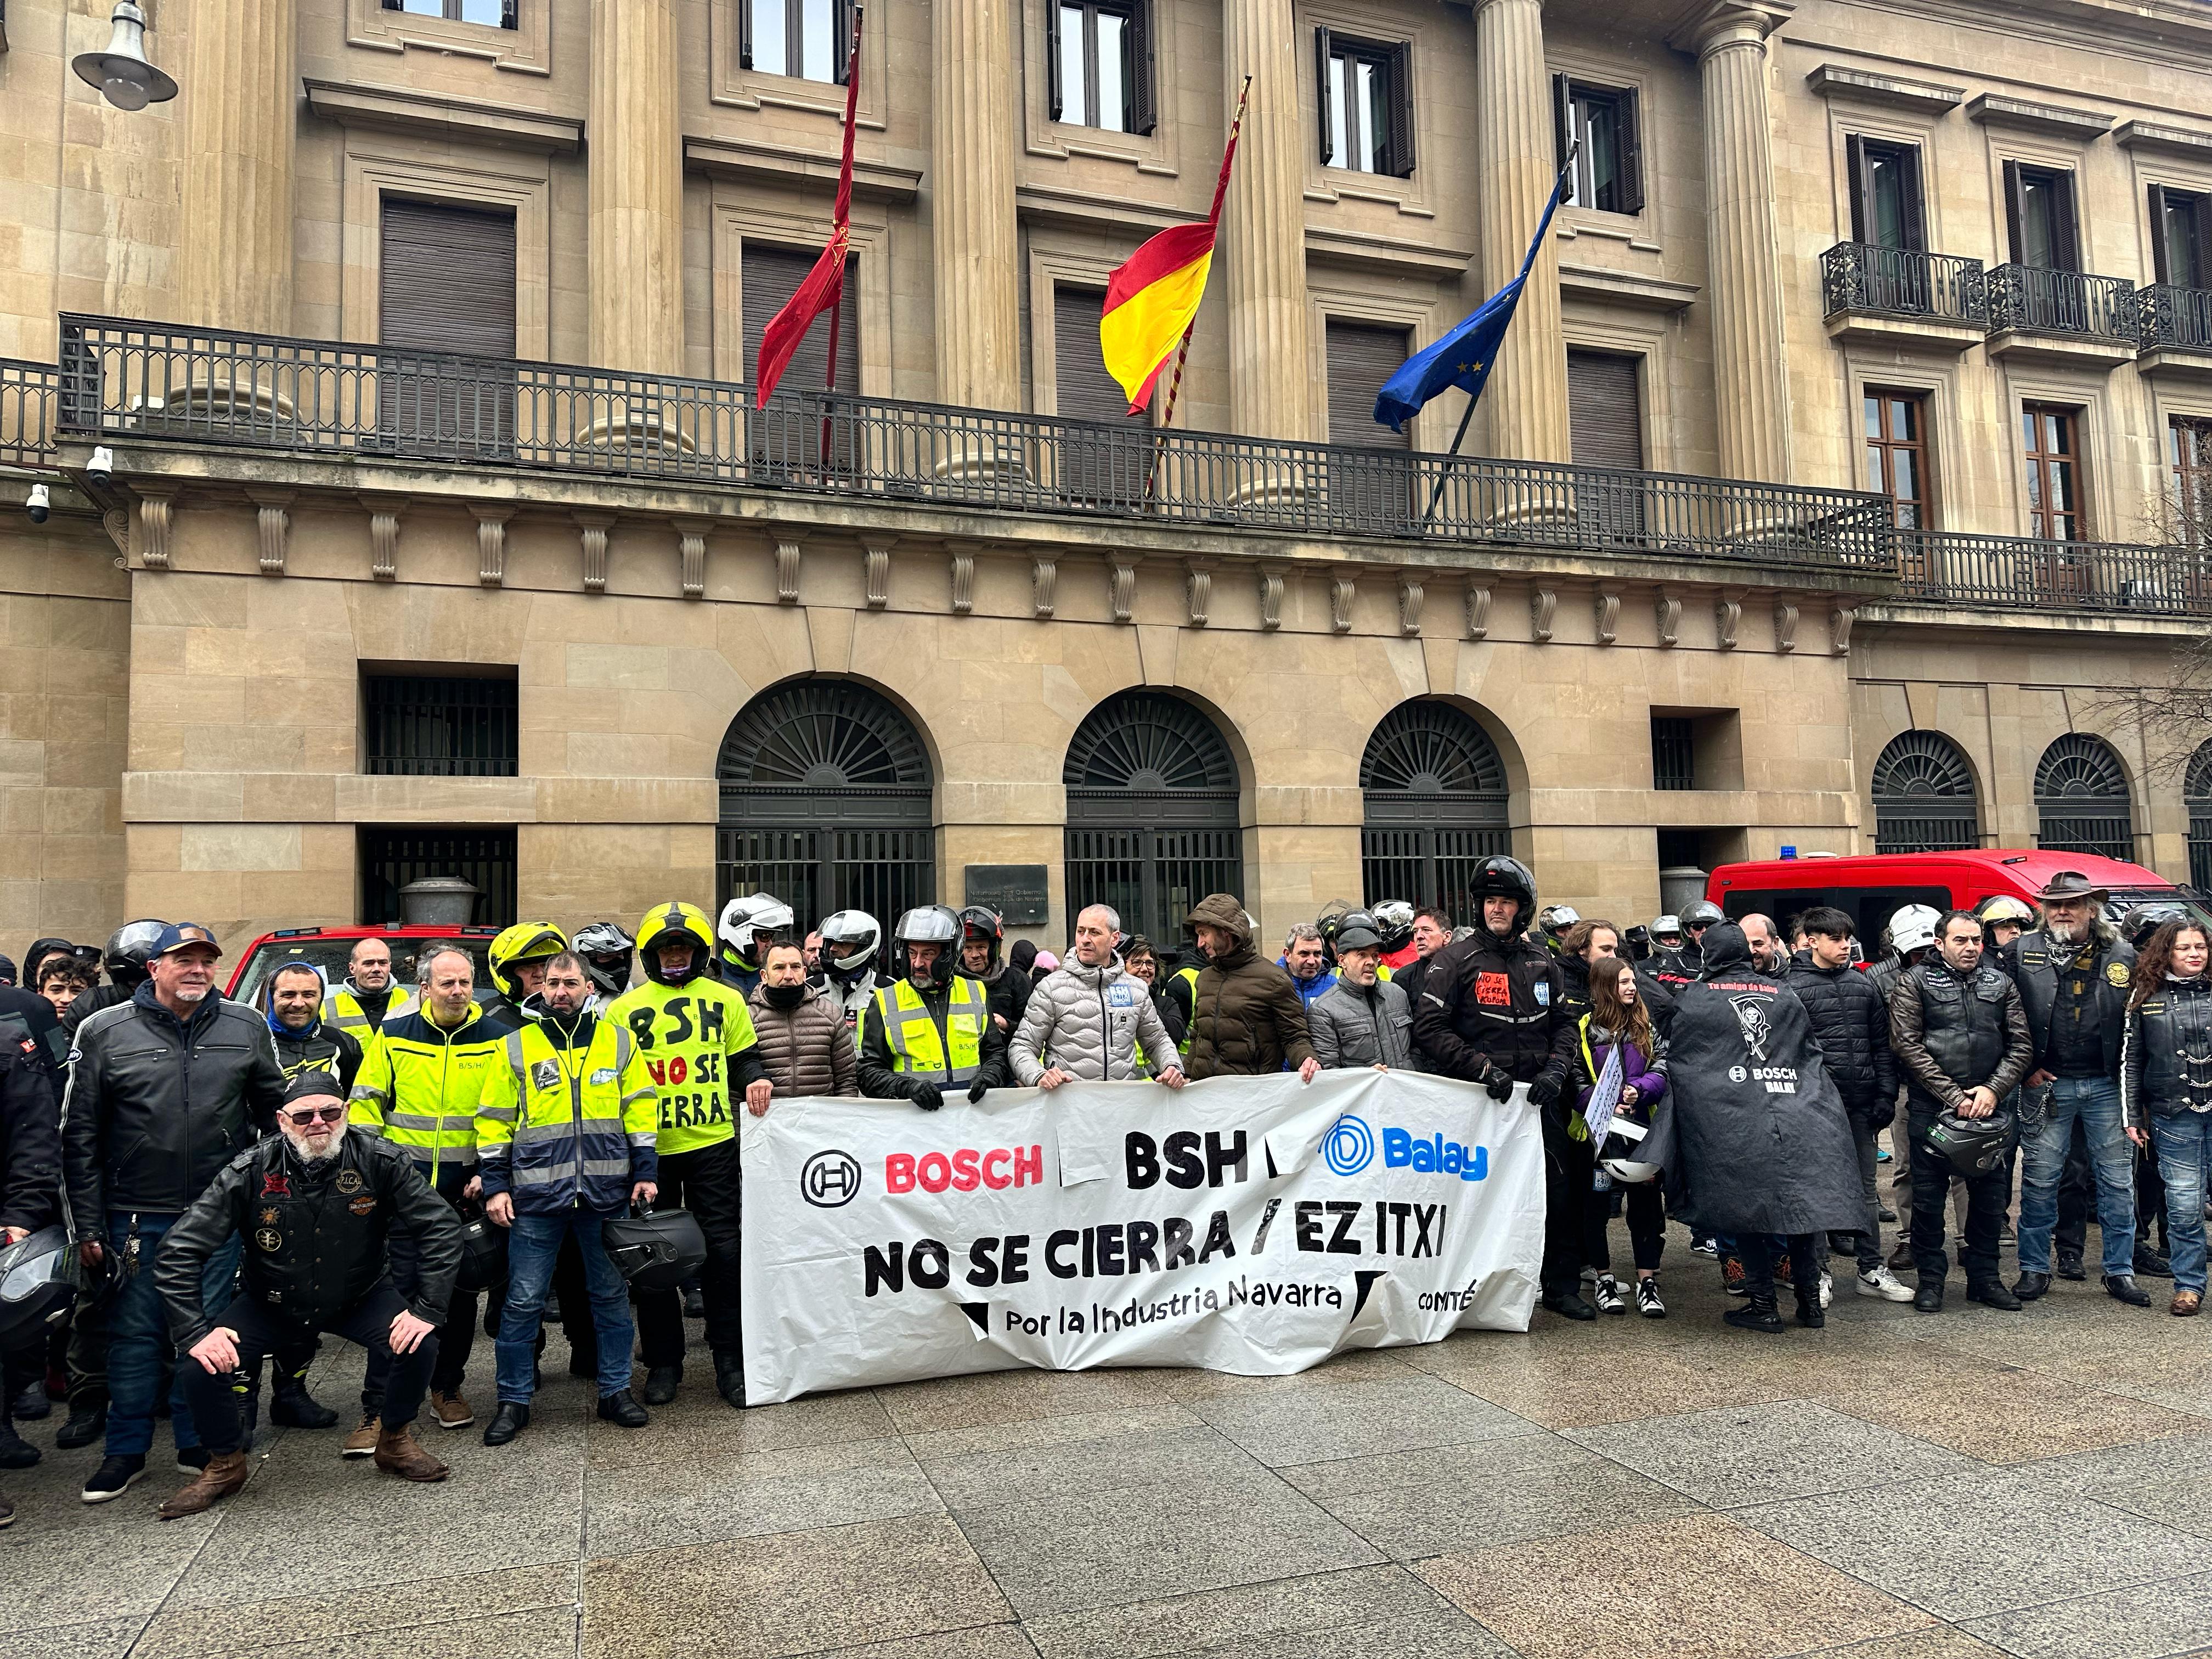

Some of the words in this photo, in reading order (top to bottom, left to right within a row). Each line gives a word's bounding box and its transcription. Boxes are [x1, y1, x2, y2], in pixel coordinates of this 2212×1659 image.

[1720, 982, 1747, 991] amigo
[1748, 983, 1759, 991] de
[629, 997, 724, 1050] BSH
[695, 1053, 720, 1084] SE
[1752, 1068, 1798, 1080] BOSCH
[1765, 1081, 1796, 1093] BALAY
[1590, 1092, 1604, 1126] SIEMENS
[885, 1144, 1042, 1193] BOSCH
[1125, 1130, 1248, 1189] BSH
[1382, 1127, 1488, 1182] Balay
[864, 1239, 950, 1297] NO
[966, 1234, 1030, 1287] SE
[1045, 1210, 1236, 1279] CIERRA
[1250, 1198, 1282, 1255] /
[1295, 1201, 1362, 1255] EZ
[1376, 1201, 1447, 1258] ITXI
[1006, 1310, 1051, 1336] Por
[1059, 1306, 1084, 1335] la
[1093, 1286, 1218, 1333] Industria
[1229, 1274, 1342, 1310] Navarra
